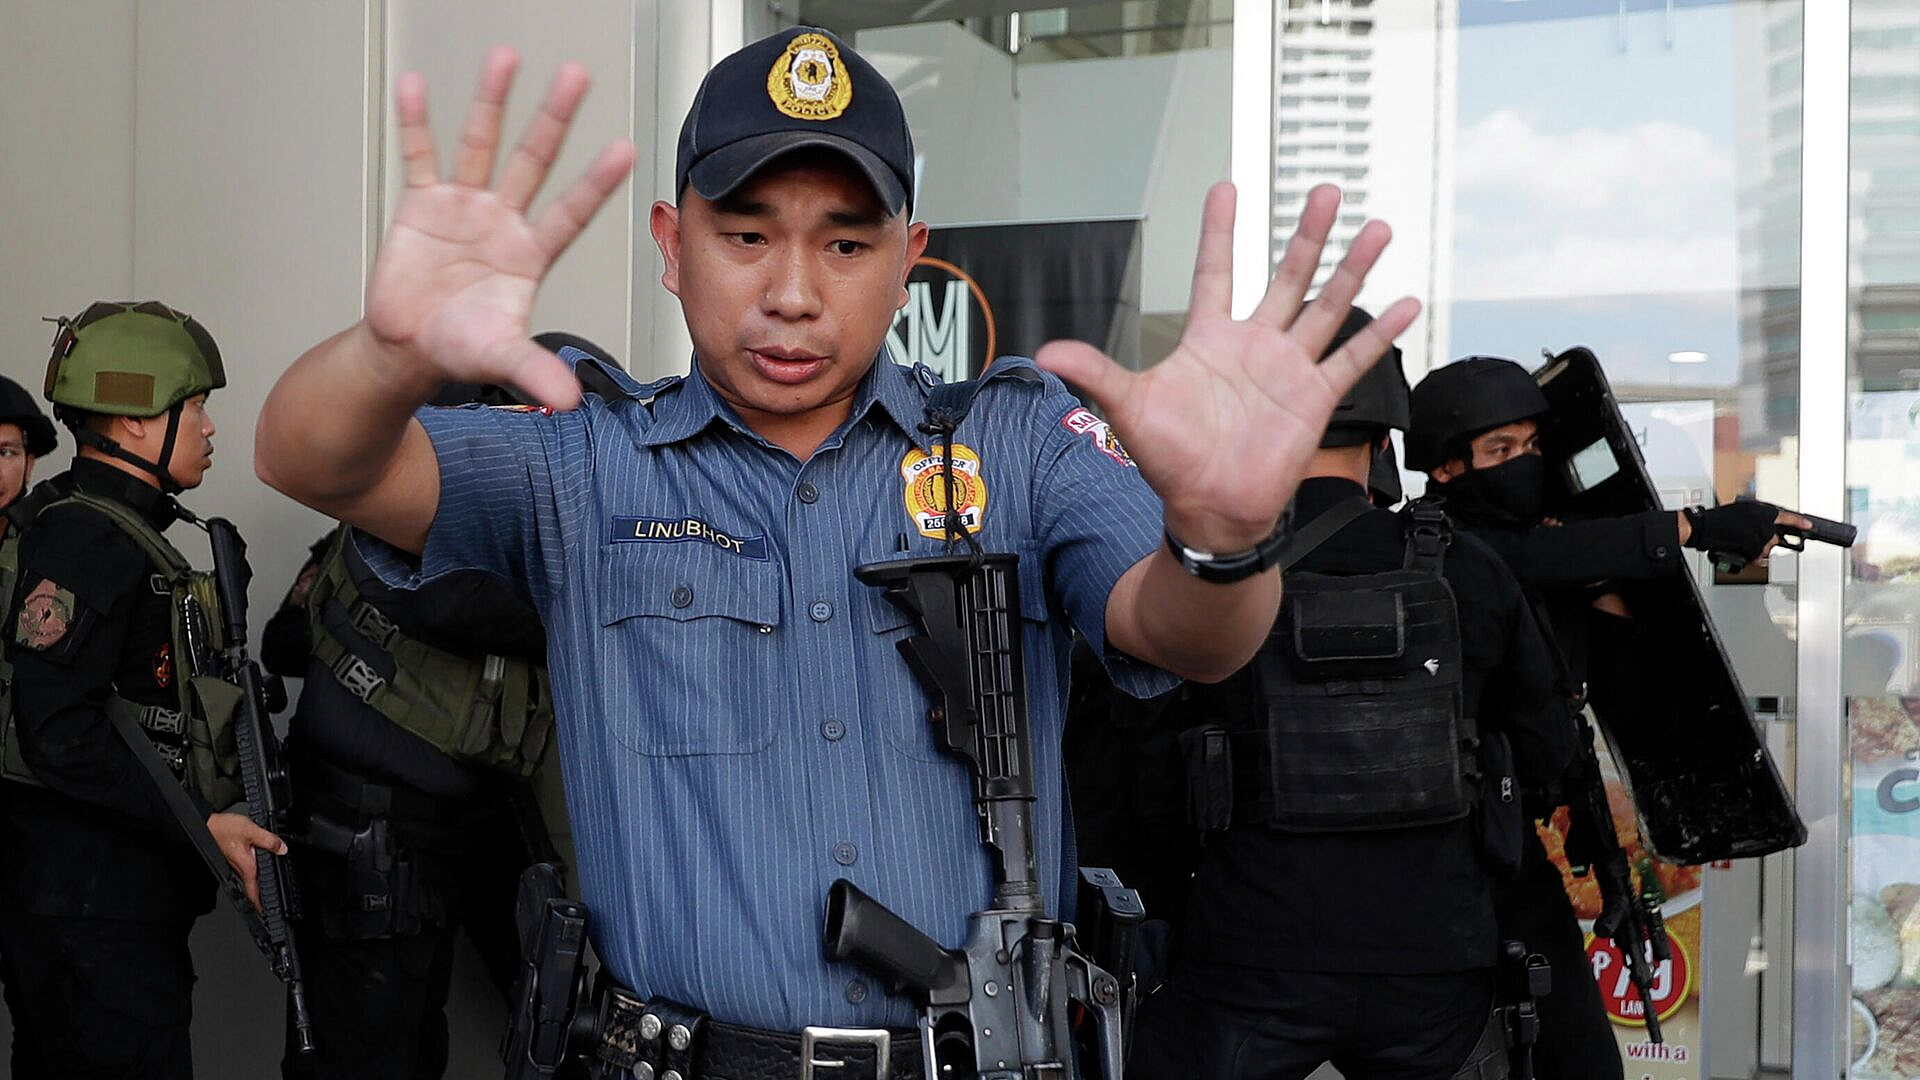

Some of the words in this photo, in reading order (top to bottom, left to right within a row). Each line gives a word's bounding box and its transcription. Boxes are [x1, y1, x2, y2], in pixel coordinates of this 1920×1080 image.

[782, 100, 837, 115] POLICE
[634, 519, 745, 553] LINUBHOT
[1620, 1000, 1645, 1015] LAN
[1626, 1041, 1670, 1059] with
